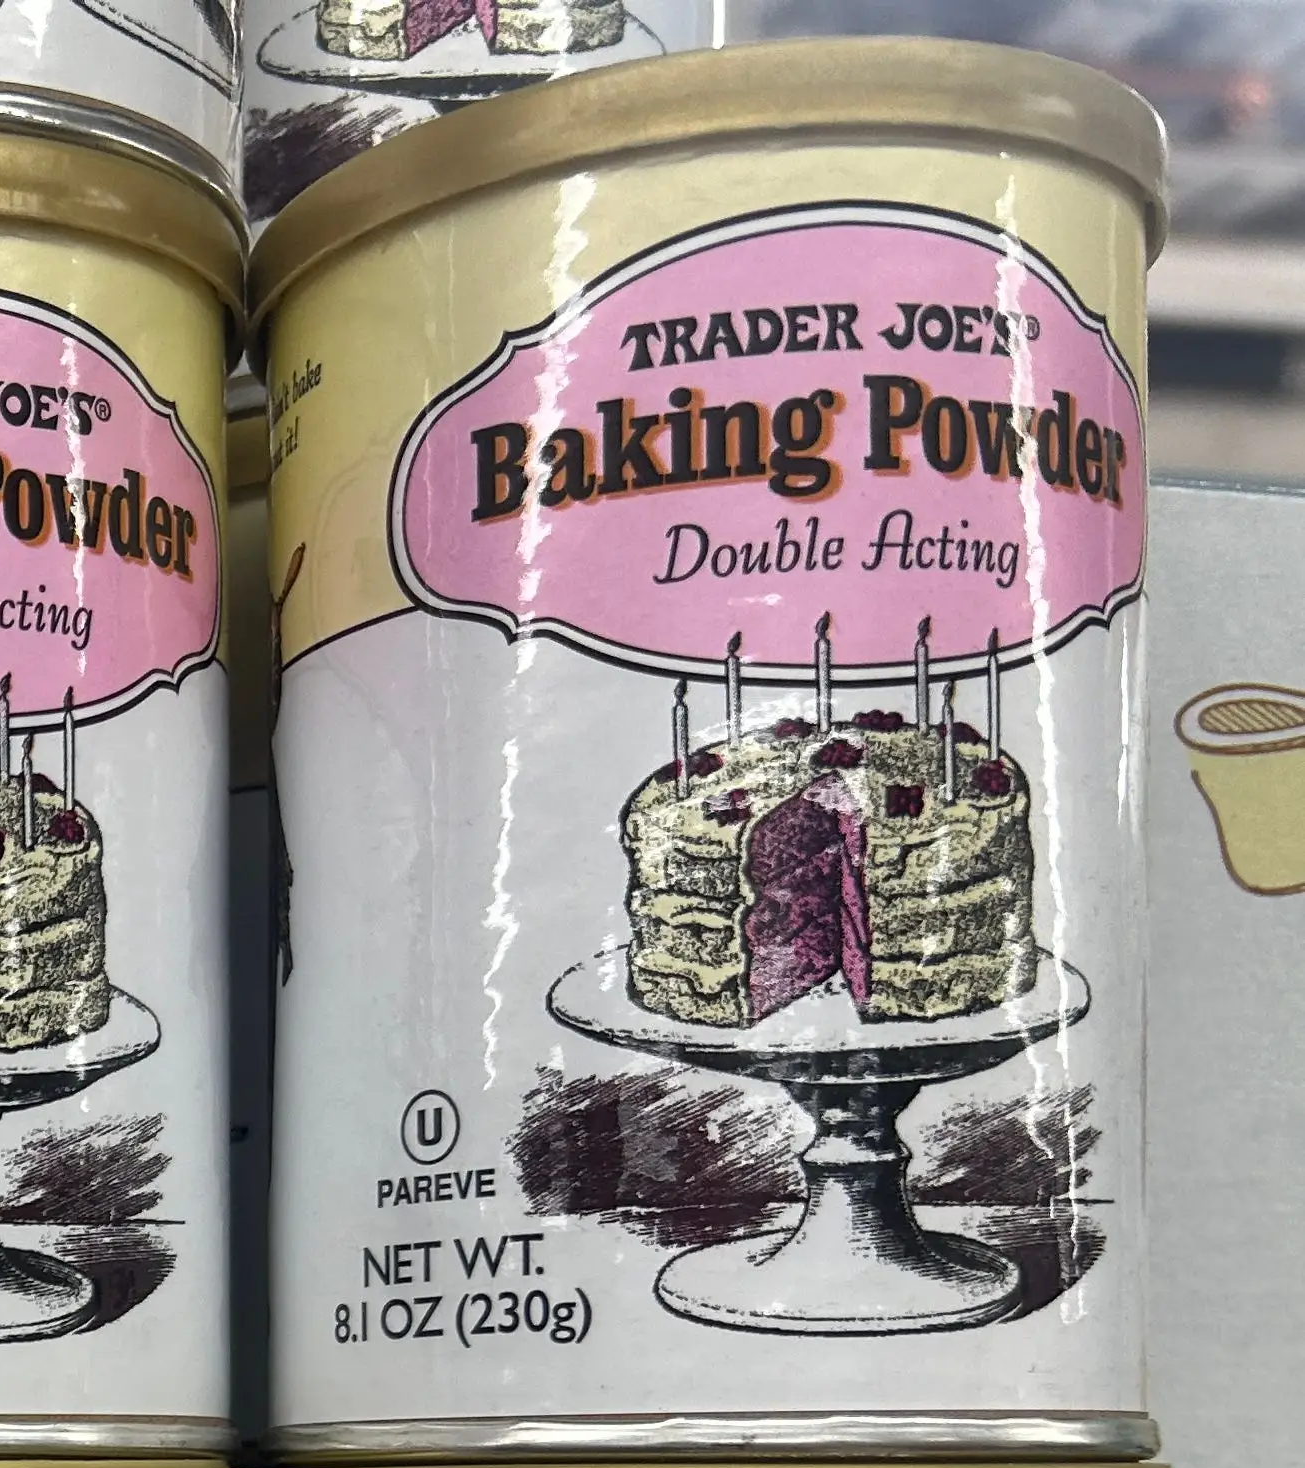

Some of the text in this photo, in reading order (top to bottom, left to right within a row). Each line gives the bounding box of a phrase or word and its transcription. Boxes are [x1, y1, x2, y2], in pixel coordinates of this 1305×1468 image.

[621, 303, 863, 371] TRADER
[470, 374, 1125, 524] Baking Powder
[654, 509, 1019, 589] Double Acting
[376, 1168, 496, 1209] PAREVE
[363, 1232, 545, 1288] NET WT.
[334, 1287, 593, 1349] 8.1 OZ (230g)
